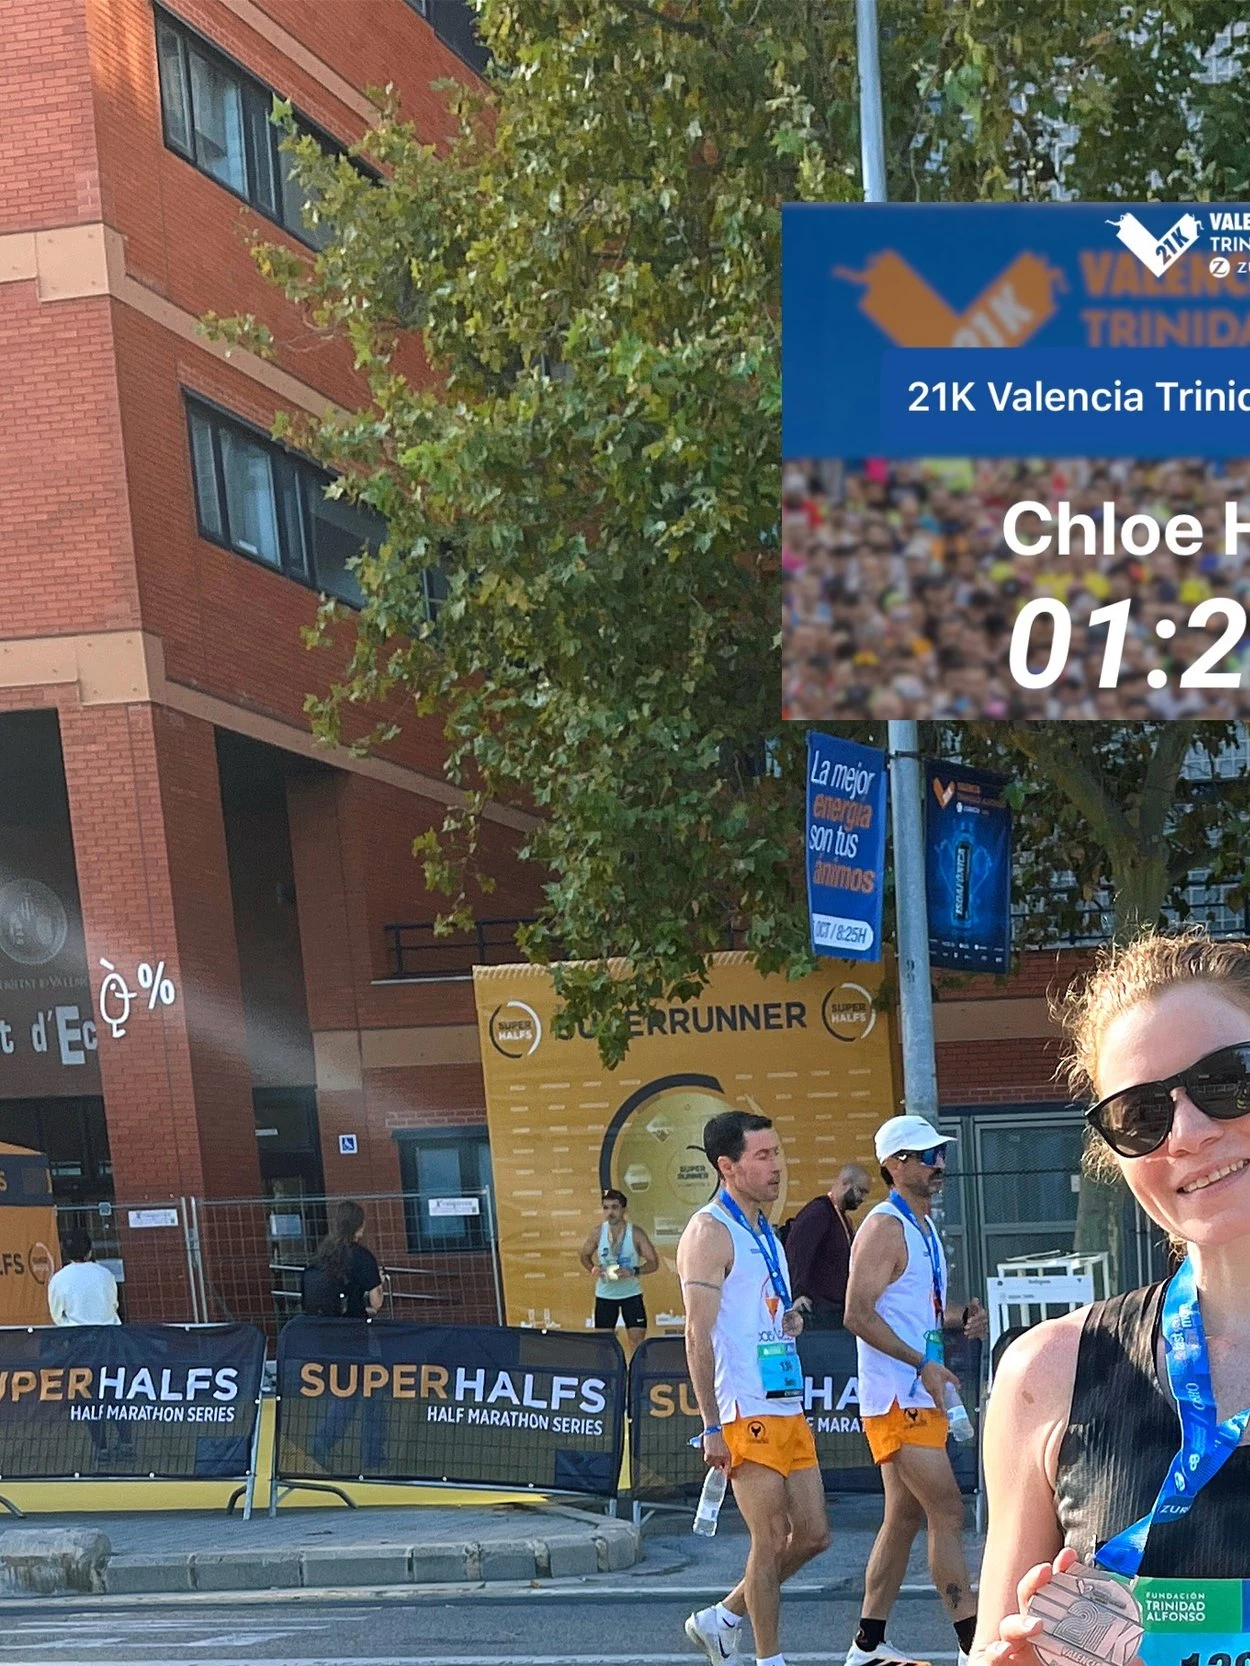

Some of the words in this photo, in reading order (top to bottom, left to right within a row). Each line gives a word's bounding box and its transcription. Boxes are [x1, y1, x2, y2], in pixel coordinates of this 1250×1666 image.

[810, 750, 828, 786] La
[831, 761, 876, 800] mejor
[809, 824, 833, 853] son
[834, 825, 859, 859] tus
[830, 1003, 867, 1013] SUPER
[831, 1012, 867, 1024] HALFS
[498, 1020, 532, 1031] SUPER
[498, 1030, 533, 1041] HALFS
[300, 1363, 607, 1415] SUPERHALFS
[70, 1404, 104, 1421] HALF
[106, 1404, 184, 1422] MARATHON
[187, 1405, 236, 1423] SERIES
[427, 1405, 464, 1426] HALF
[467, 1408, 548, 1431] MARATHON
[551, 1414, 604, 1437] SERIES
[1145, 1591, 1206, 1600] FUNDACIÓN
[1145, 1600, 1206, 1611] TRINIDAD
[1145, 1611, 1206, 1622] ALFONSO
